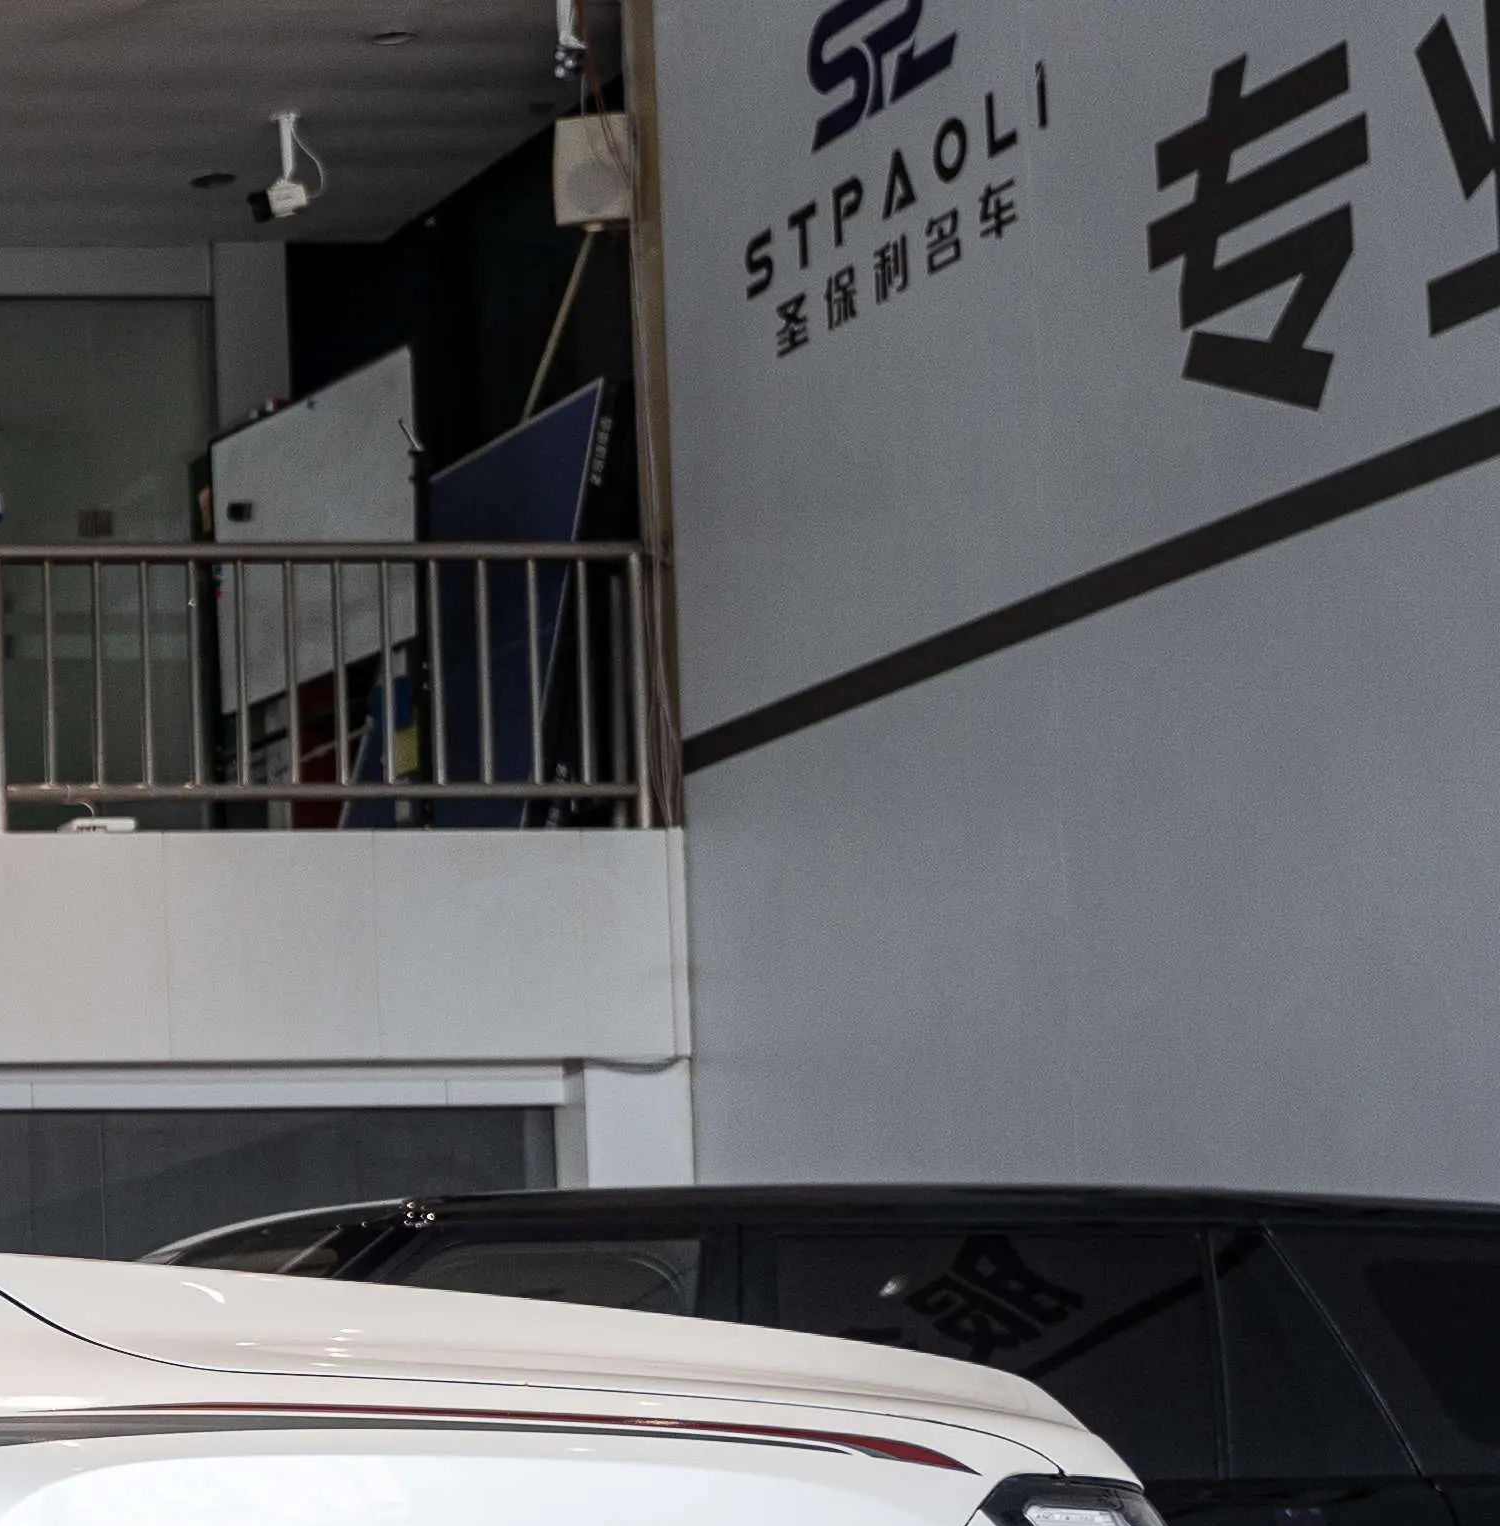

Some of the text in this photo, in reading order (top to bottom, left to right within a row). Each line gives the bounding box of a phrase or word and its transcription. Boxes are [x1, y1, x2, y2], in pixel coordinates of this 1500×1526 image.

[744, 59, 1048, 301] STPAOLI
[775, 177, 1019, 359] 圣保利名车
